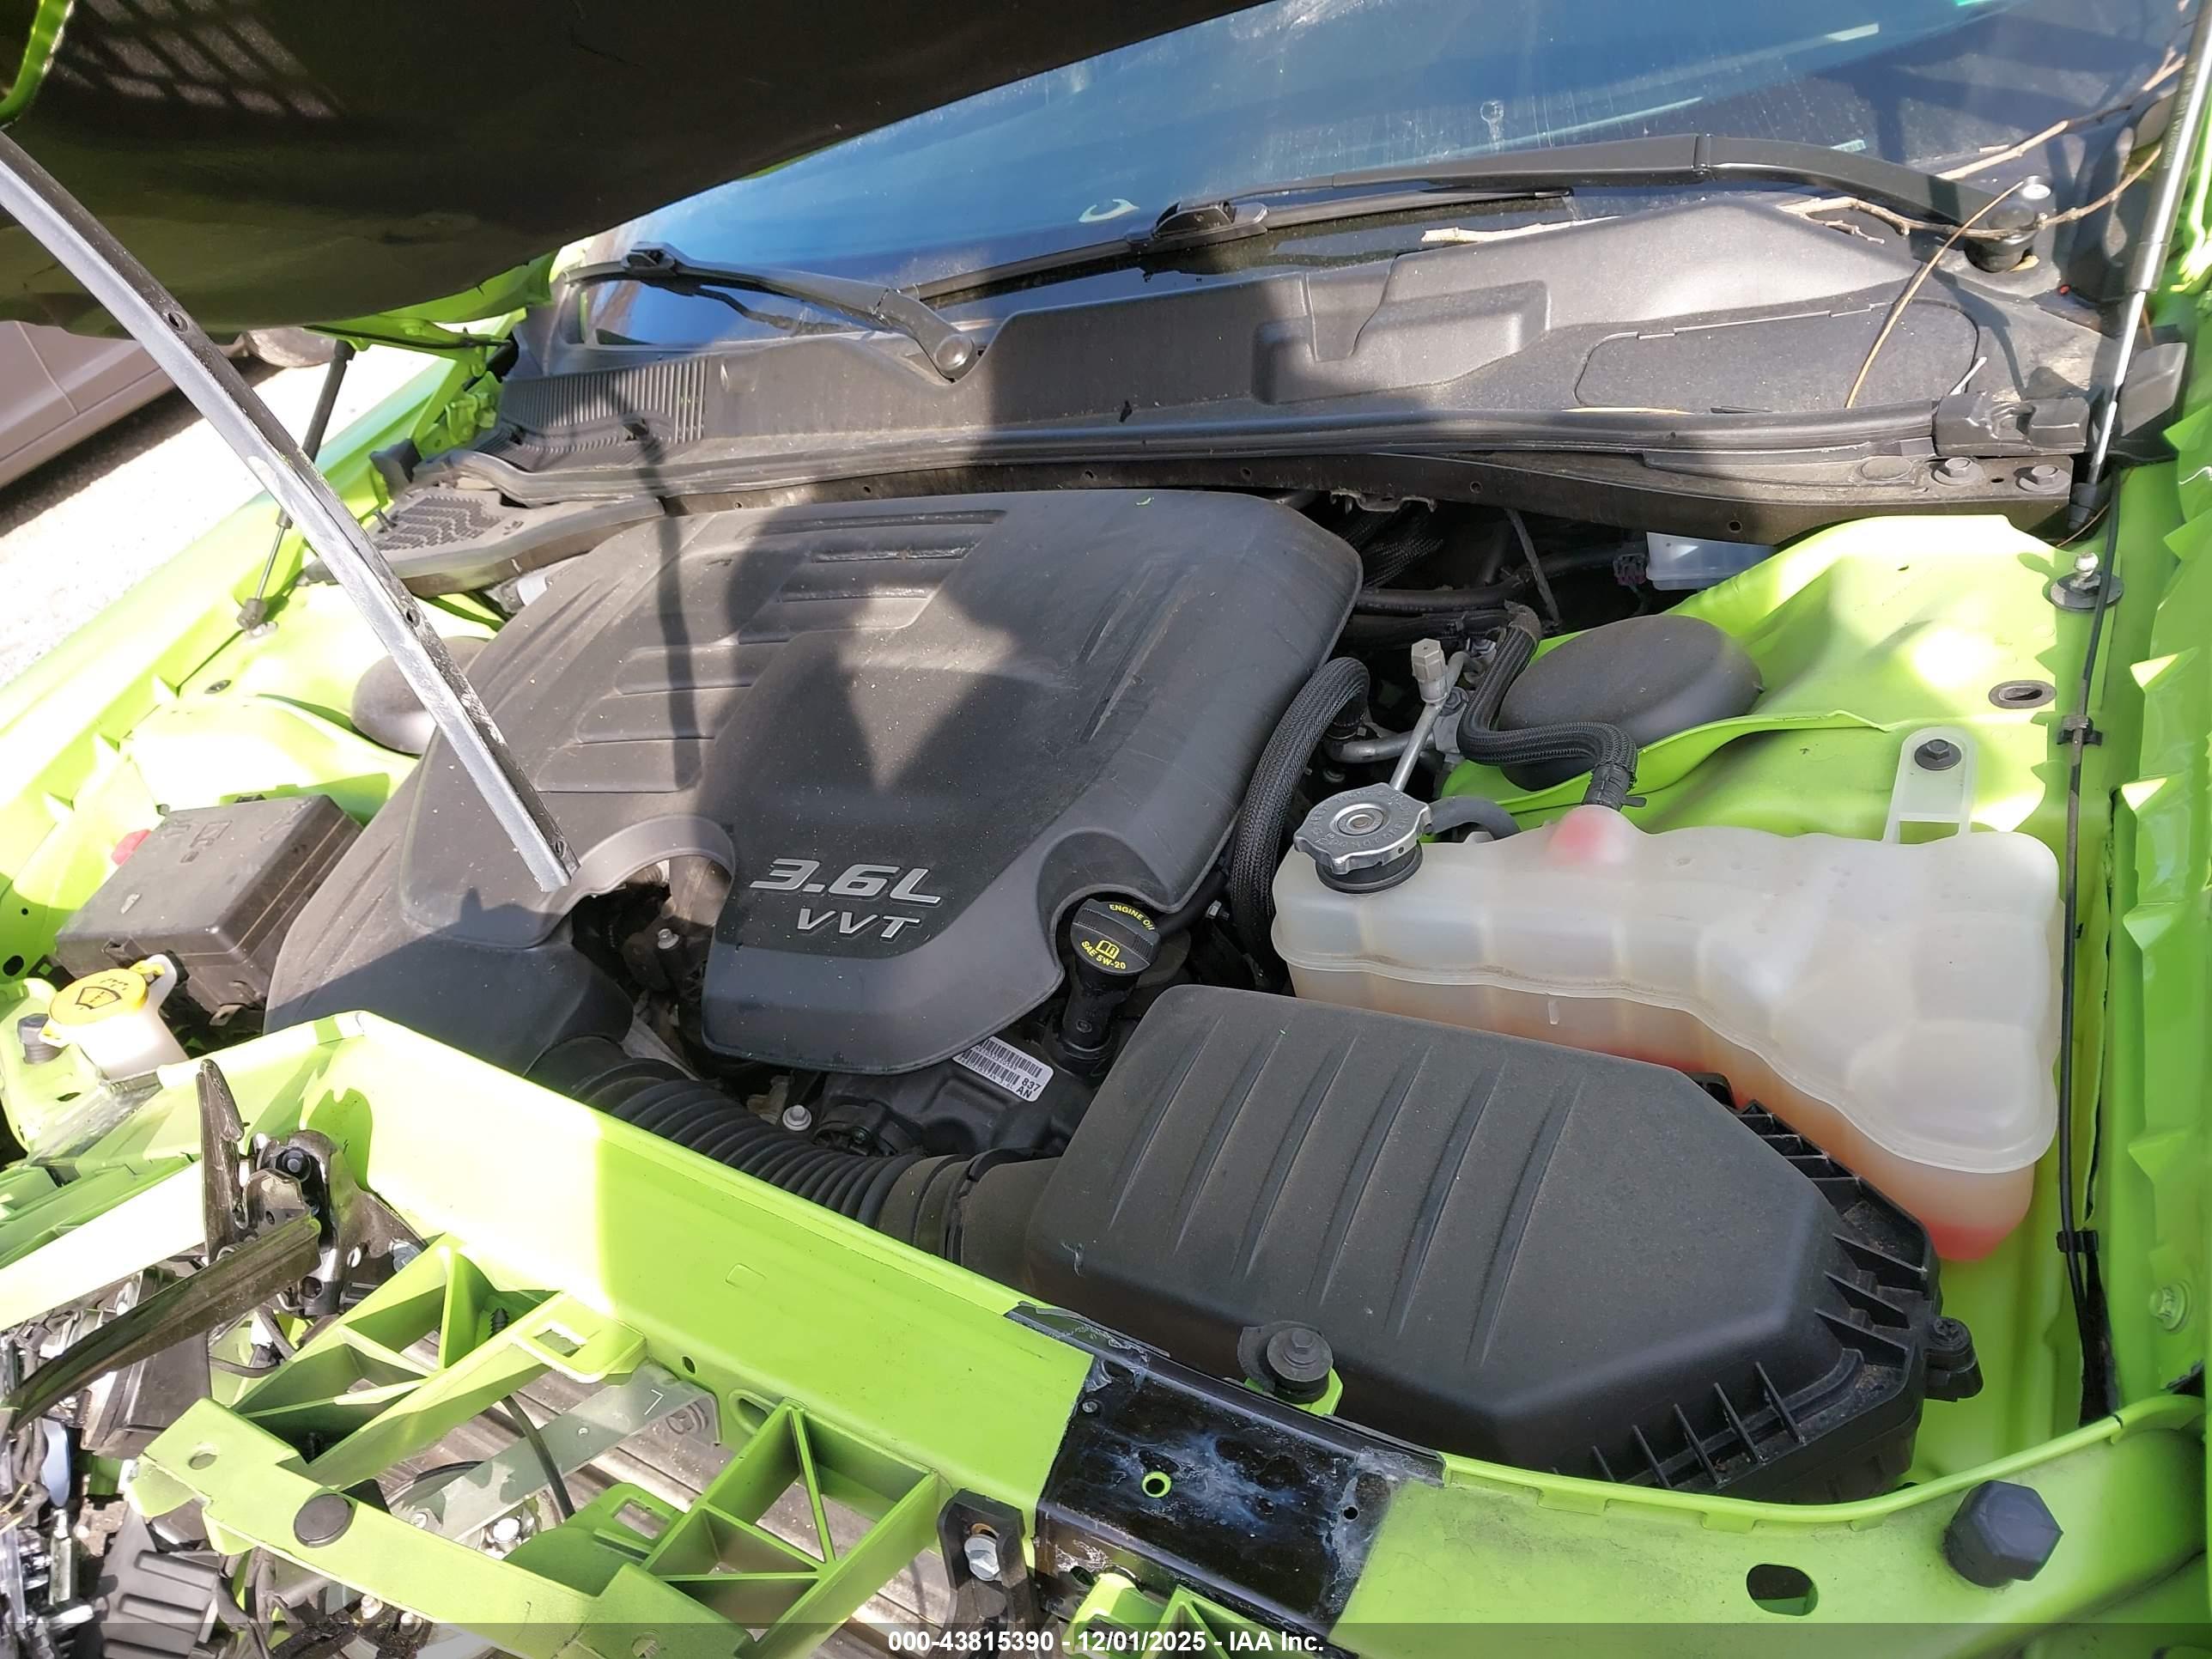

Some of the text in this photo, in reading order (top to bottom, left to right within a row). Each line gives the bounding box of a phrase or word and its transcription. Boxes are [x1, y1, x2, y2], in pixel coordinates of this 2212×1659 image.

[749, 858, 942, 904] 3.6L
[797, 908, 921, 939] VVT
[1109, 903, 1145, 921] ENGINE
[1081, 940, 1127, 970] SAE 5W-20
[1015, 1085, 1033, 1099] AN
[1021, 1077, 1042, 1092] 837
